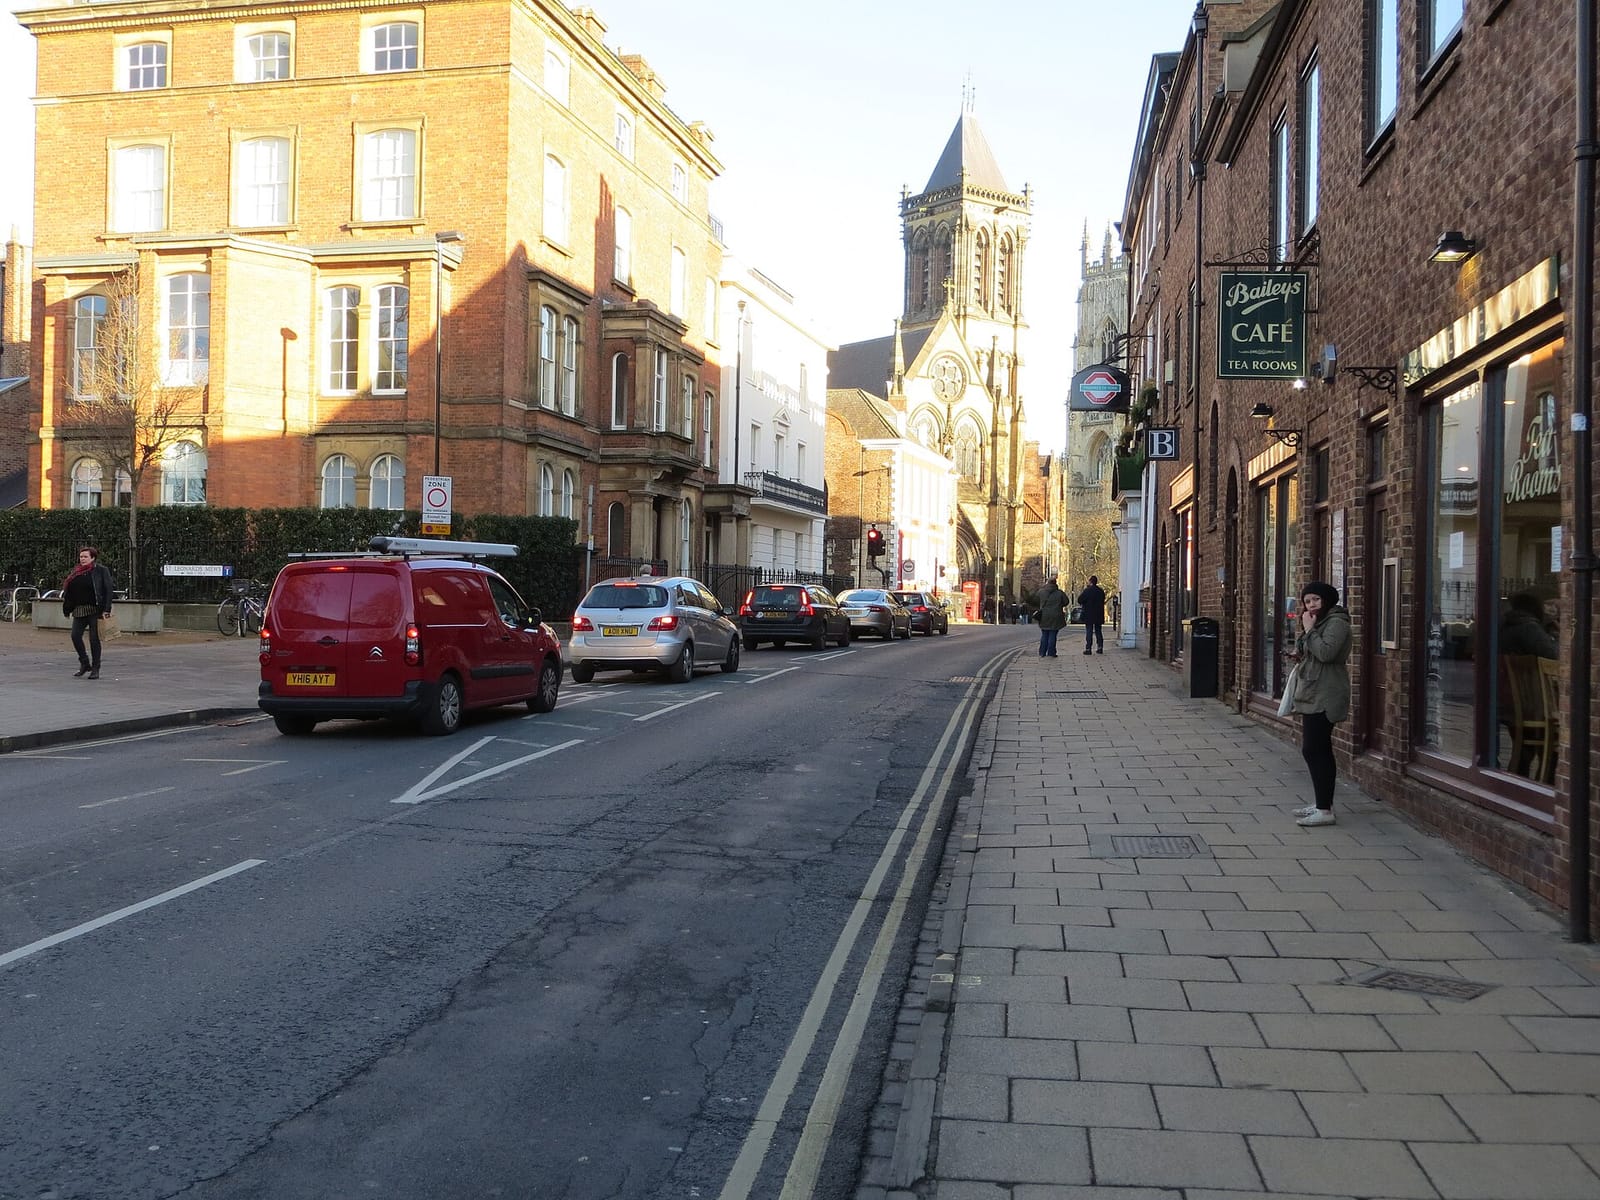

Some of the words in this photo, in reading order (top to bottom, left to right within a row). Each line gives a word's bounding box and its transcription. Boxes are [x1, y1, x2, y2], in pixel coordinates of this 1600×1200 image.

[1226, 279, 1301, 307] Baileys
[1232, 318, 1292, 342] CAFÉ
[1228, 360, 1248, 370] TEA
[1252, 360, 1297, 371] ROOMS
[1151, 432, 1173, 456] B
[1523, 416, 1557, 463] Tea
[1506, 459, 1562, 504] Rooms
[292, 674, 310, 684] YH16
[314, 674, 330, 683] AYT
